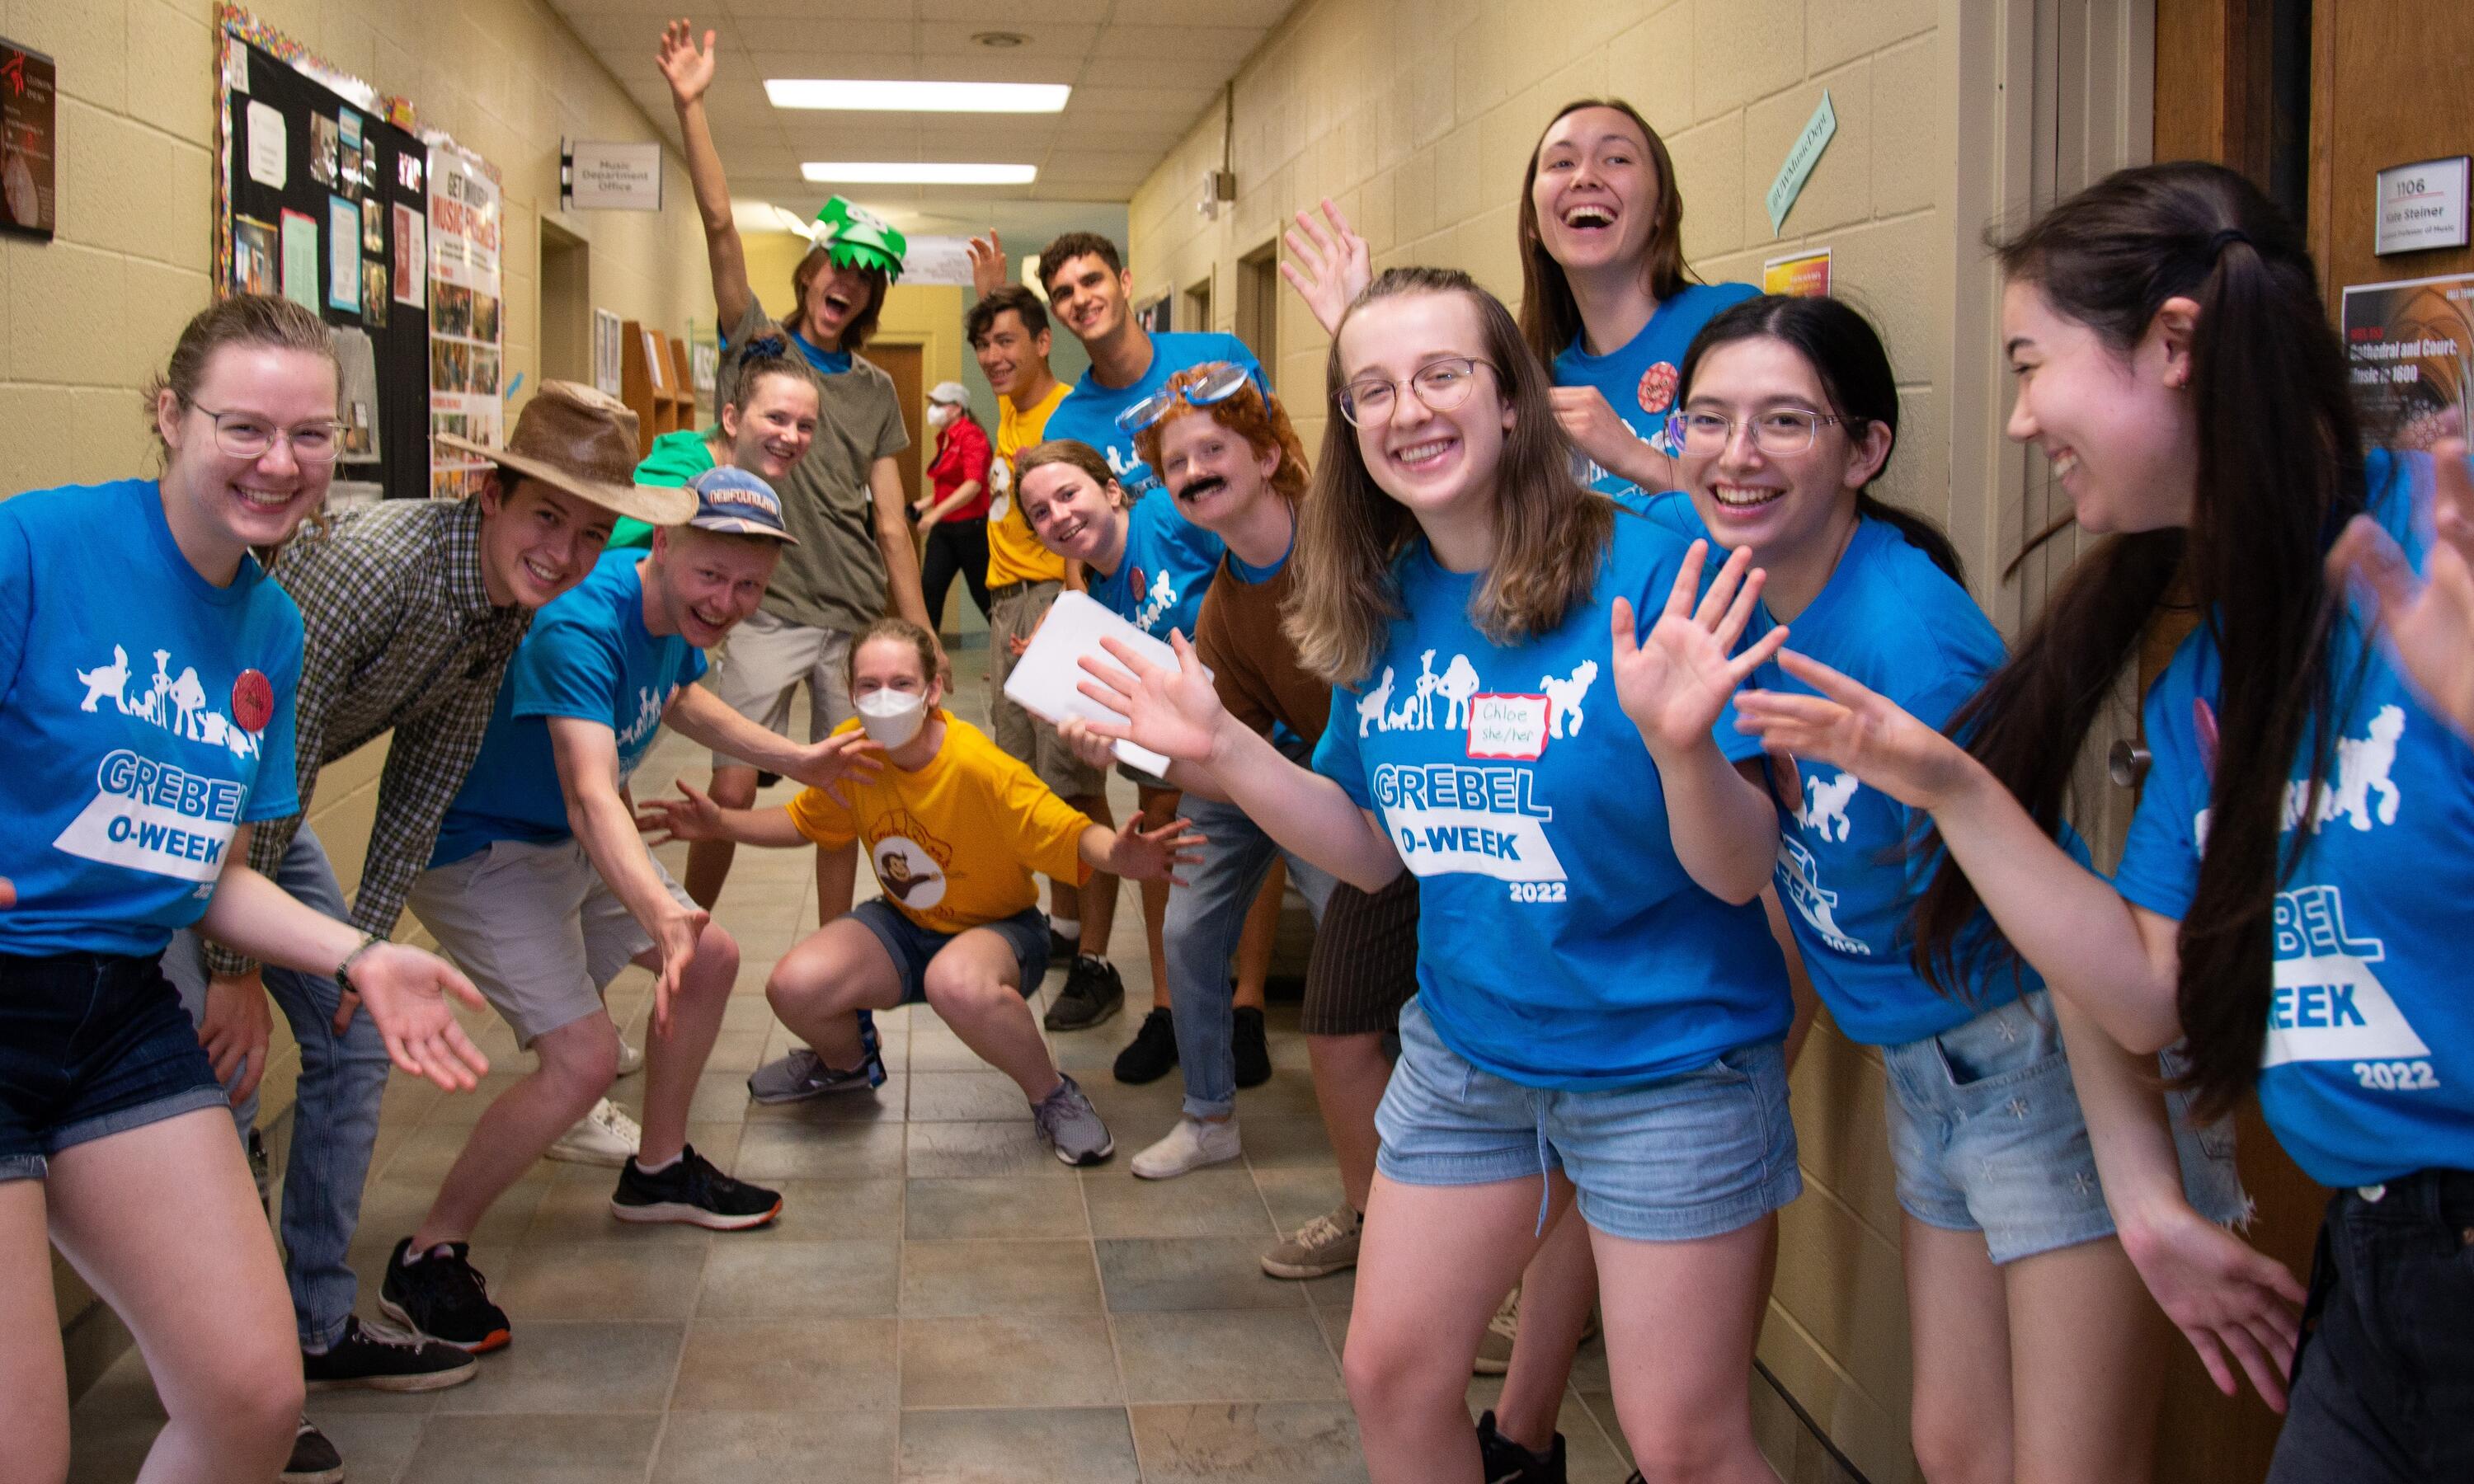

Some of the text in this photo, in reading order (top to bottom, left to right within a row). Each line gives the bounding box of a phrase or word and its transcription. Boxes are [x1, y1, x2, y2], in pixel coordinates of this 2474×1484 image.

[1772, 113, 1827, 207] @UWMusicDept
[582, 170, 648, 181] Department
[599, 182, 632, 191] Office
[2396, 178, 2425, 197] 1106
[433, 194, 463, 237] MUSIC
[2404, 206, 2443, 220] Steiner
[2350, 340, 2399, 361] Cathedral
[2401, 340, 2420, 358] and
[2392, 364, 2418, 383] 1600
[1483, 702, 1528, 721] Chloe
[1482, 726, 1534, 743] she/her
[1374, 763, 1553, 823] GREBEL
[108, 814, 225, 865] O-WEEK
[1401, 824, 1522, 862] O-WEEK
[1509, 882, 1567, 903] 2022
[2274, 885, 2386, 963] BEL
[2271, 984, 2367, 1029] EEK
[2353, 1060, 2441, 1091] 2022
